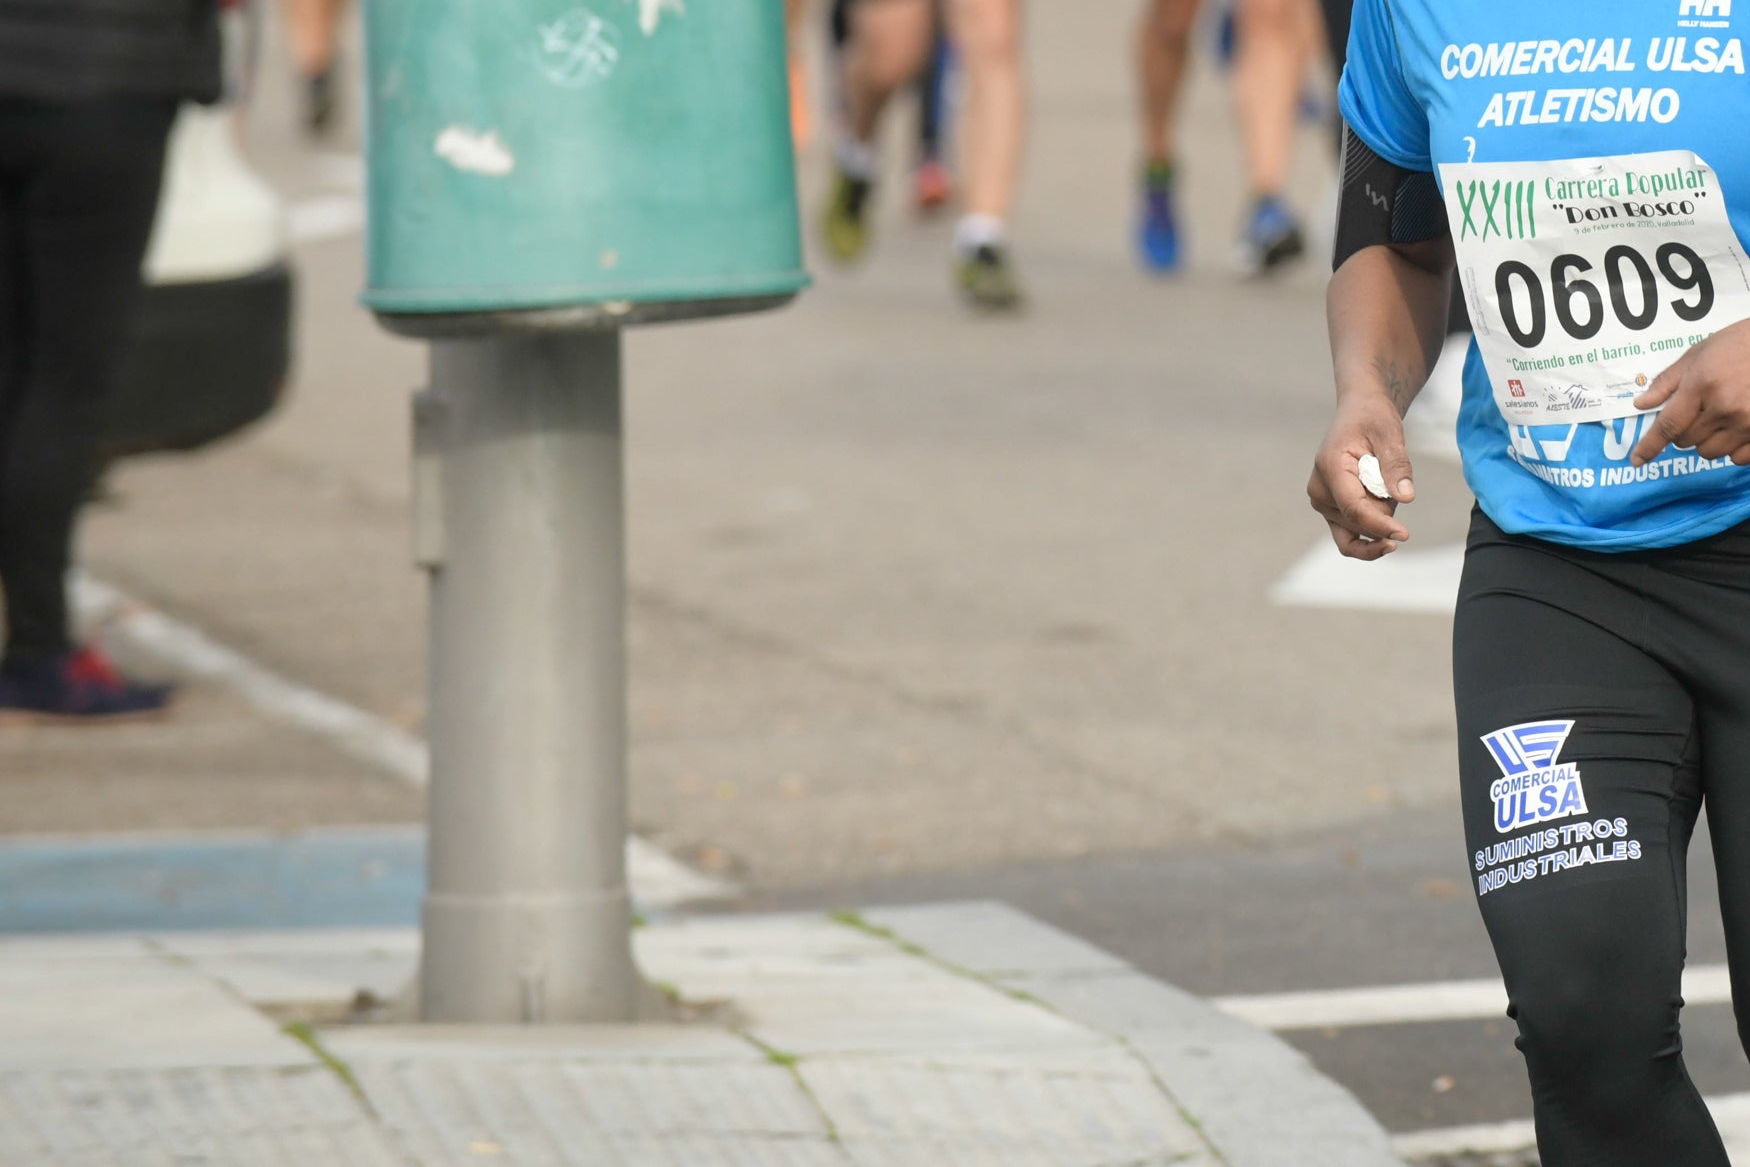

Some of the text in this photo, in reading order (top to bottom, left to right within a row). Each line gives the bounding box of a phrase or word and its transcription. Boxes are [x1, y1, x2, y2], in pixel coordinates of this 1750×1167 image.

[1440, 37, 1745, 80] COMERCIAL ULSA
[1477, 87, 1680, 128] ATLETISMO
[1545, 167, 1707, 200] Carrera Popular
[1457, 179, 1535, 242] XXIII
[1552, 191, 1707, 224] "Don Bosco"
[1593, 222, 1624, 232] febrero
[1495, 242, 1715, 348] 0609
[1506, 355, 1565, 372] "Corriendo
[1569, 353, 1583, 365] en
[1587, 349, 1598, 363] el
[1602, 342, 1646, 361] barrio,
[1650, 339, 1684, 352] como
[1688, 333, 1703, 347] en
[1504, 400, 1538, 408] salesianos
[1492, 765, 1576, 799] COMERCIAL
[1496, 779, 1584, 831] ULSA
[1475, 817, 1628, 871] SUMINISTROS
[1478, 839, 1642, 897] INDUSTRIALES
